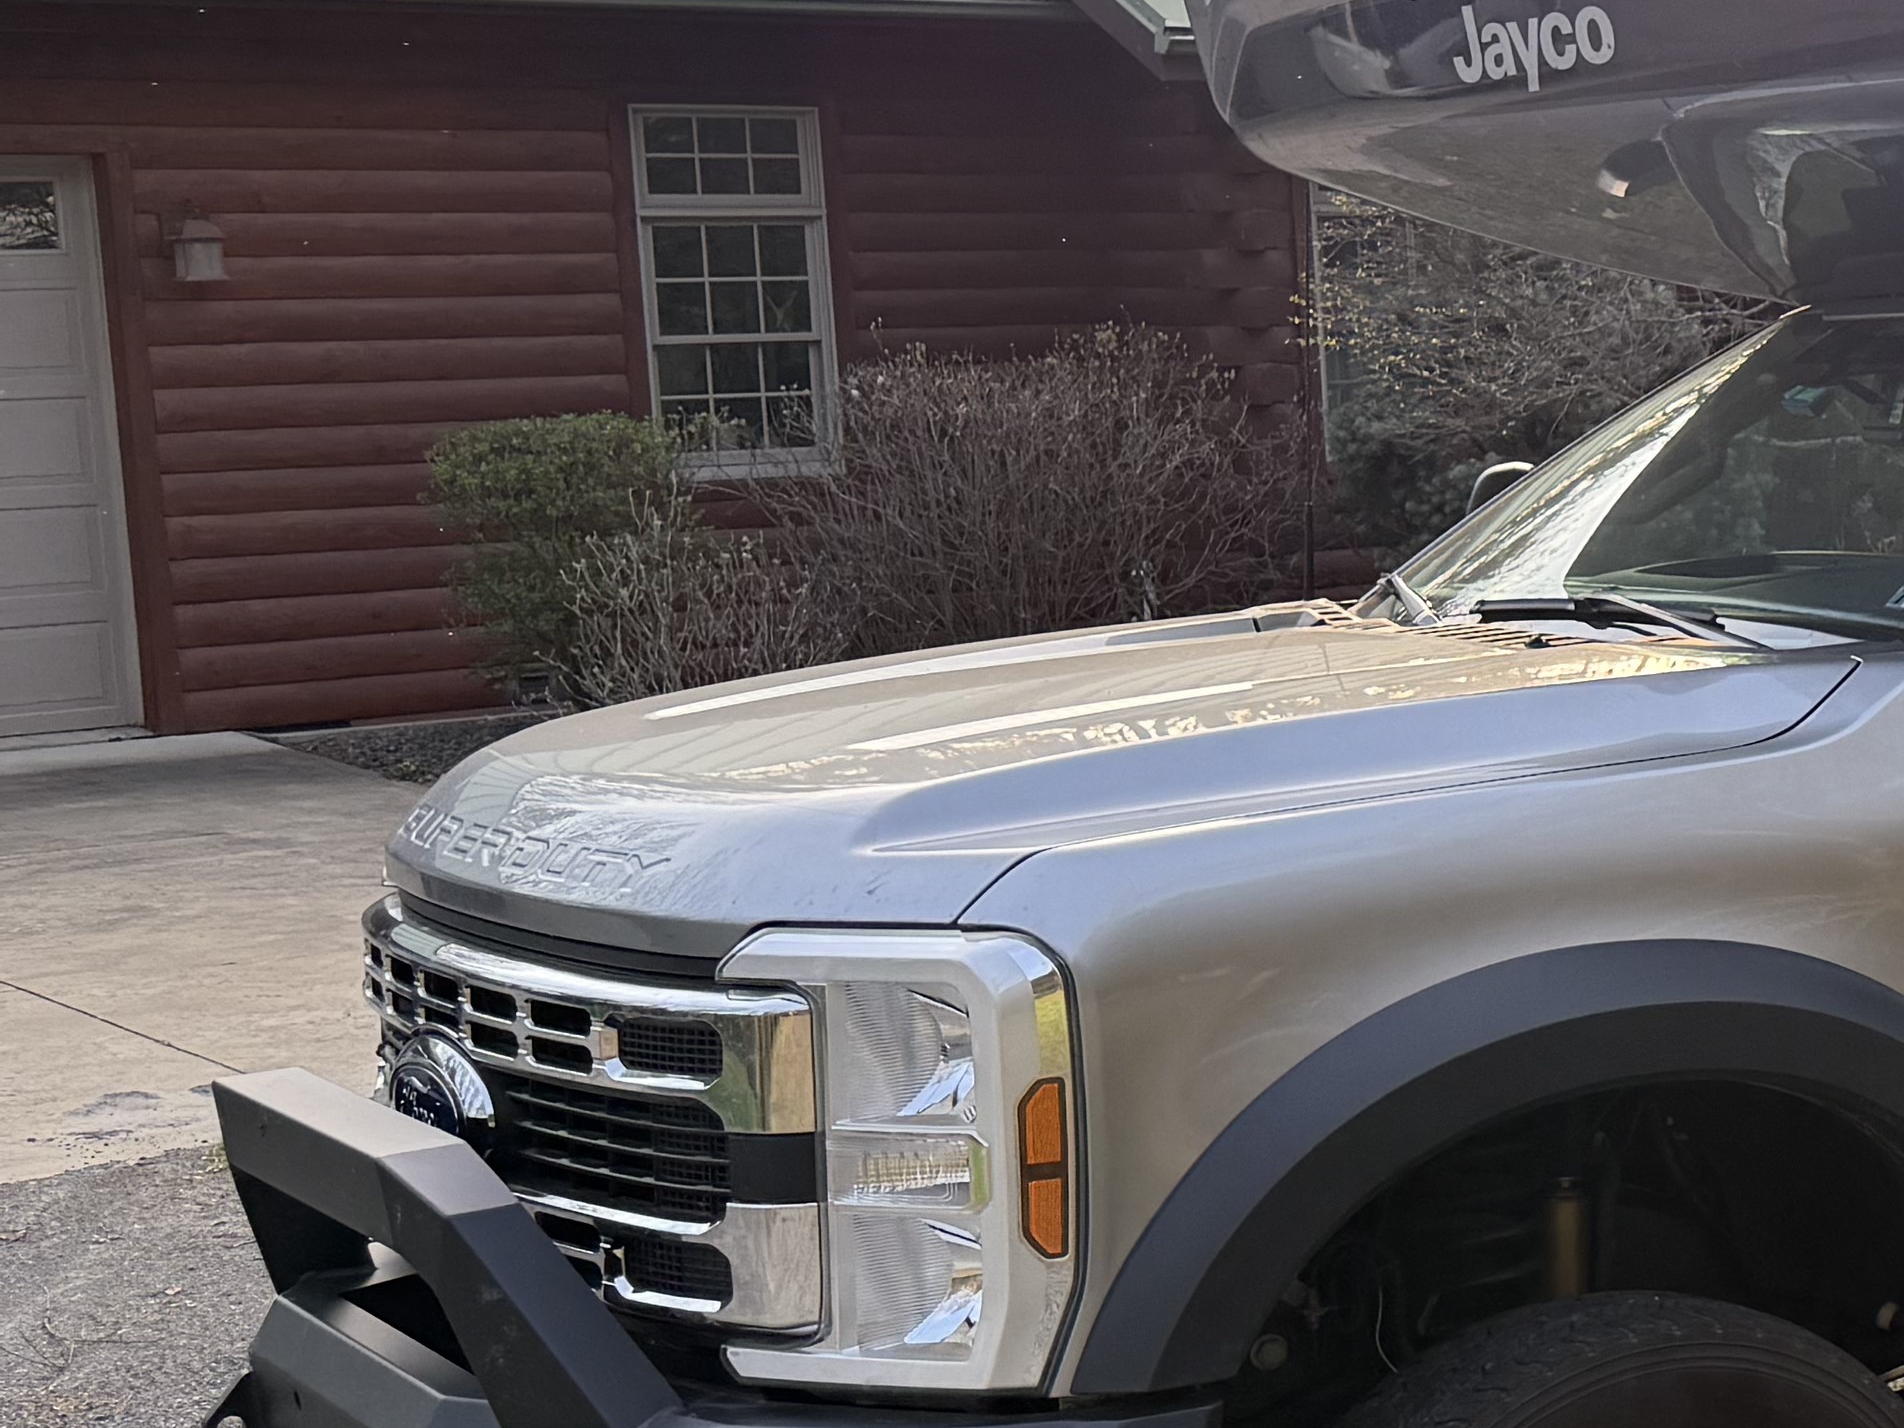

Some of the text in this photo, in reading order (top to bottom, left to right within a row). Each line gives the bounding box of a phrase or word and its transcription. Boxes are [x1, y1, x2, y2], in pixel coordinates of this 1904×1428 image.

[1453, 5, 1615, 92] Jayco
[399, 803, 671, 892] SUPER DUTY
